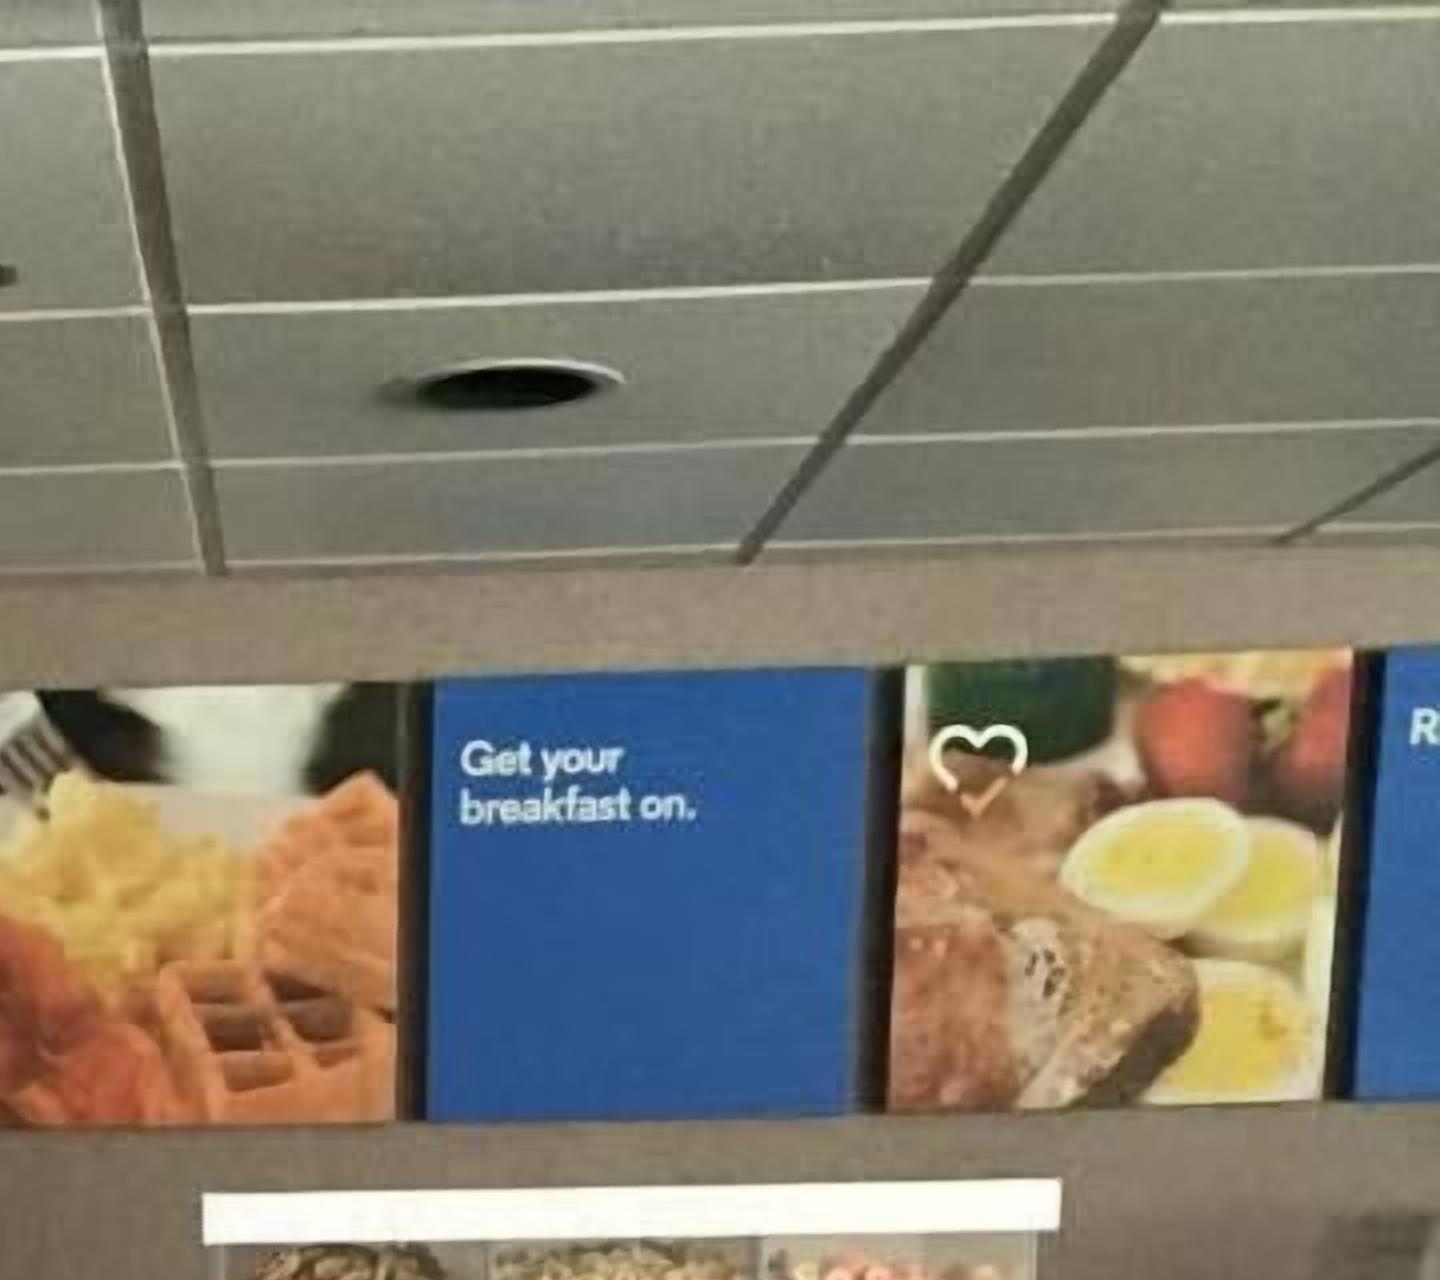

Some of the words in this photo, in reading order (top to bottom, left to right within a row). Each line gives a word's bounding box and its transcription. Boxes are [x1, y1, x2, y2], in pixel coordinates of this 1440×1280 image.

[460, 740, 532, 776] Get
[541, 747, 625, 782] your
[460, 784, 631, 825] breakfast
[640, 794, 697, 821] on.
